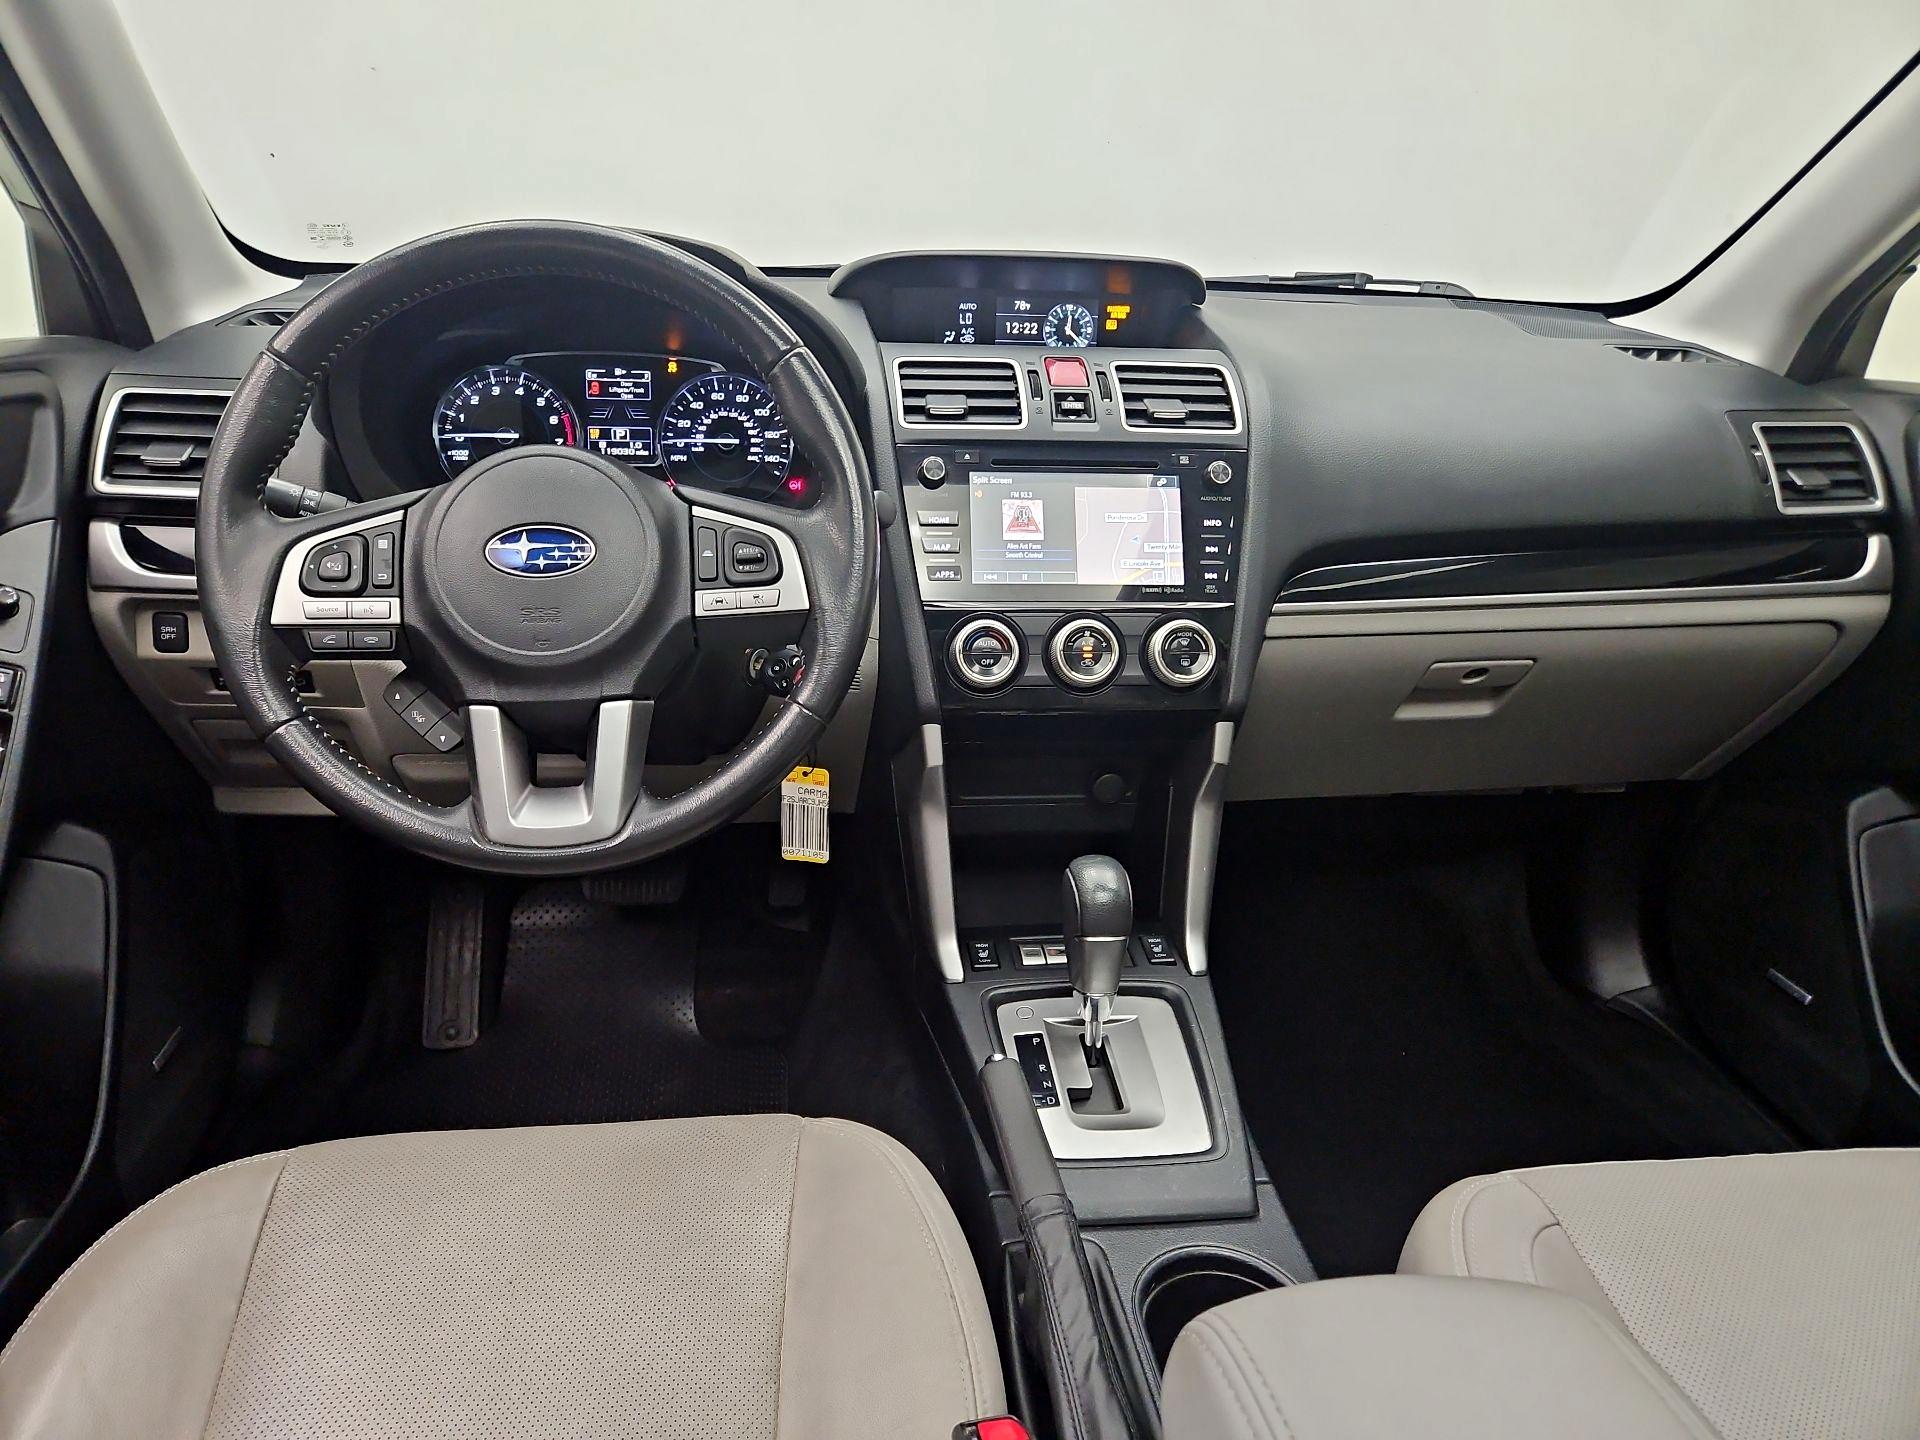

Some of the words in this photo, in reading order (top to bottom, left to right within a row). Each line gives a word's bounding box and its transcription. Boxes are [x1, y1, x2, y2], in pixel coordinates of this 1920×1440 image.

[1005, 322, 1039, 335] 12:22
[491, 386, 500, 396] 3
[515, 386, 524, 396] 4
[470, 396, 480, 405] 2
[536, 397, 545, 406] 5
[549, 416, 559, 424] 6
[677, 420, 691, 428] 20
[615, 429, 626, 440] P
[972, 476, 988, 485] Split
[990, 476, 1013, 484] Screen
[928, 516, 950, 524] HOME
[520, 608, 561, 616] SRS
[783, 848, 824, 859] 0071105
[1032, 1038, 1040, 1046] P
[1039, 1064, 1047, 1072] R
